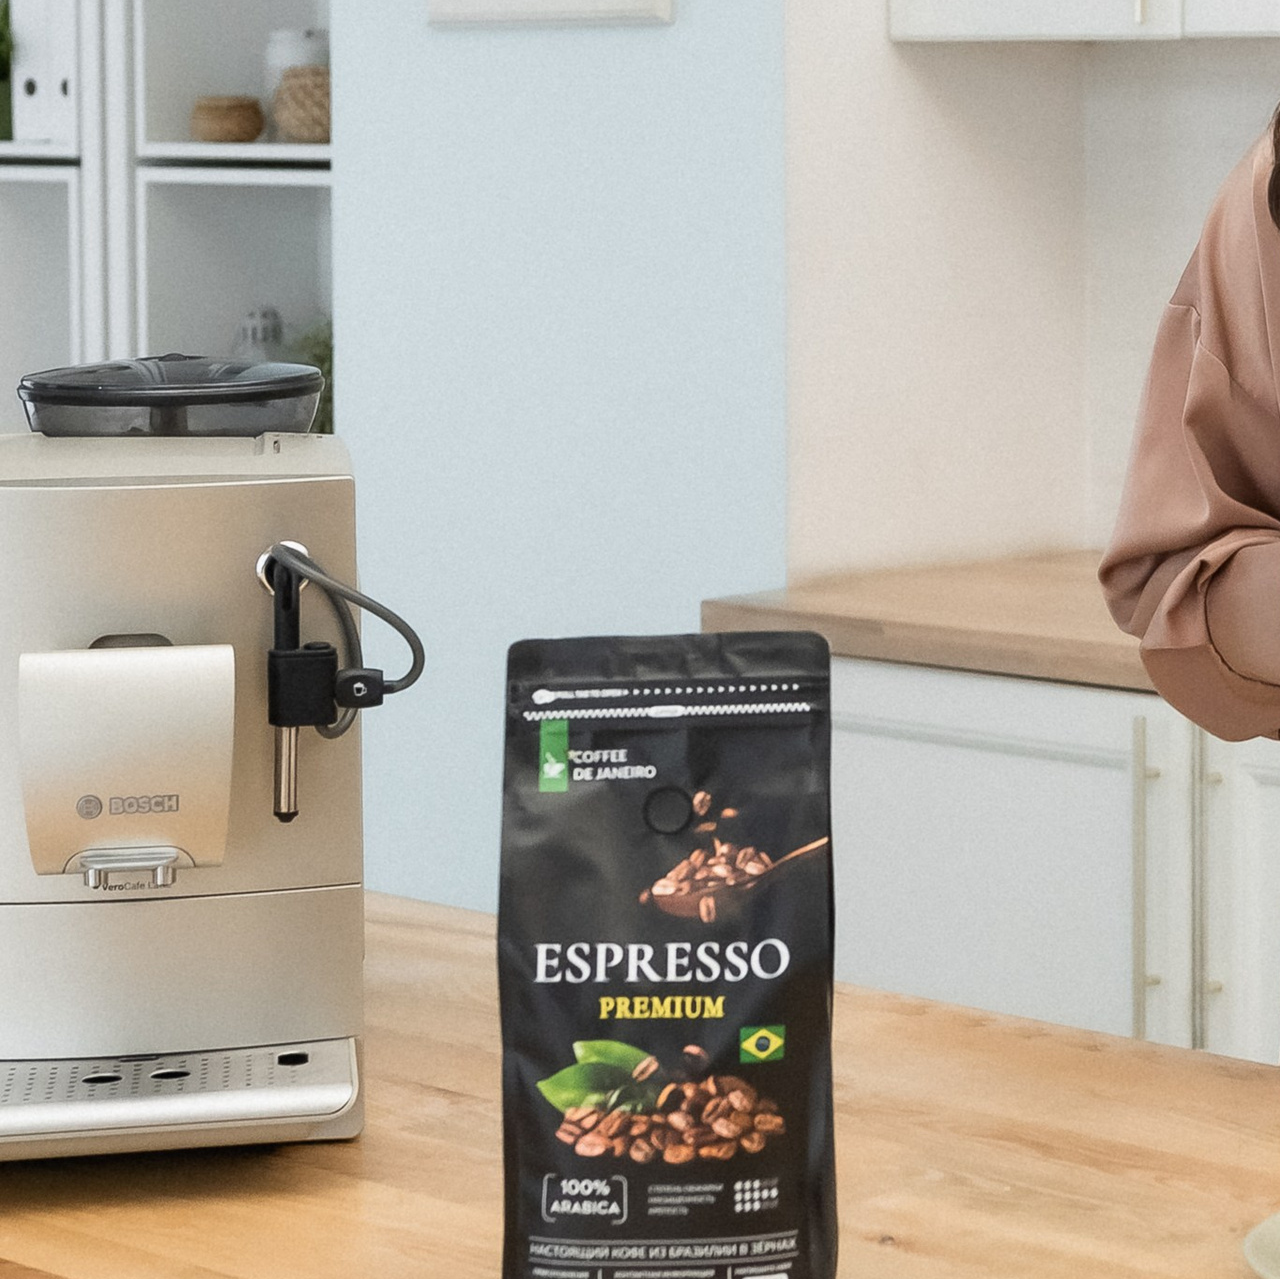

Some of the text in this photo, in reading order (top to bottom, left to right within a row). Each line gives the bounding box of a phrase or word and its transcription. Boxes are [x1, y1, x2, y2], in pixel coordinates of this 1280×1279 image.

[572, 749, 628, 764] COFFEE
[572, 765, 658, 781] DE JANEIRO
[109, 795, 179, 815] BOSCH
[533, 938, 791, 984] ESPRESSO
[599, 995, 726, 1020] PREMIUM
[560, 1178, 611, 1196] 100%
[550, 1199, 622, 1216] ARABICA
[611, 1246, 648, 1260] КОФЕ
[648, 1246, 667, 1259] ИЗ
[668, 1244, 738, 1260] БРАЗИЛИИ
